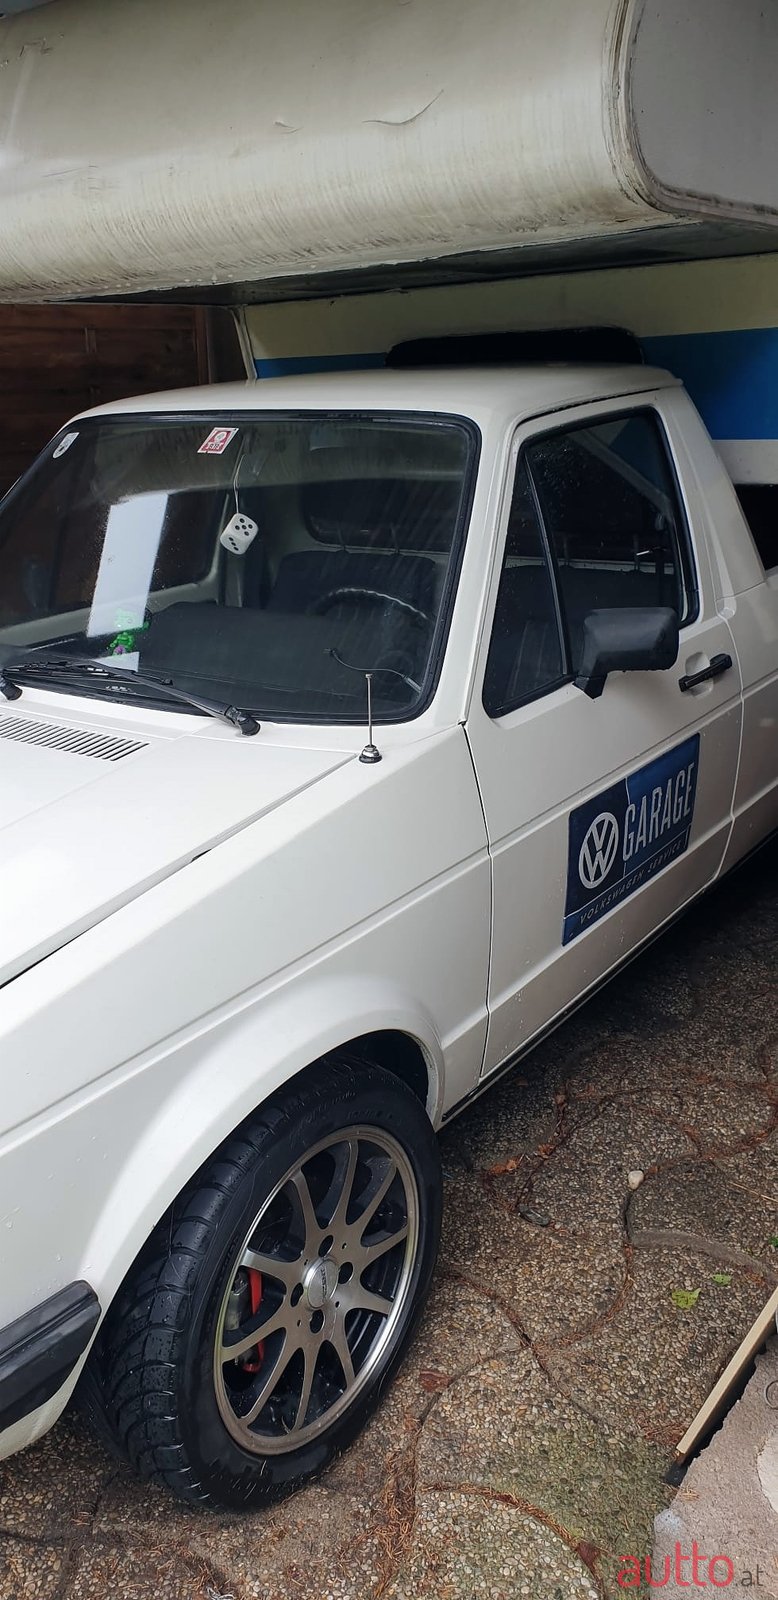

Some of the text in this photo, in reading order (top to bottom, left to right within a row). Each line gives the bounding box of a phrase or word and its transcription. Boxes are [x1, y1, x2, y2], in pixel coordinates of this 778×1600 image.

[579, 812, 619, 889] VW
[623, 763, 695, 861] GARAGE
[580, 841, 681, 924] VOLKSWAGEN SERVICE
